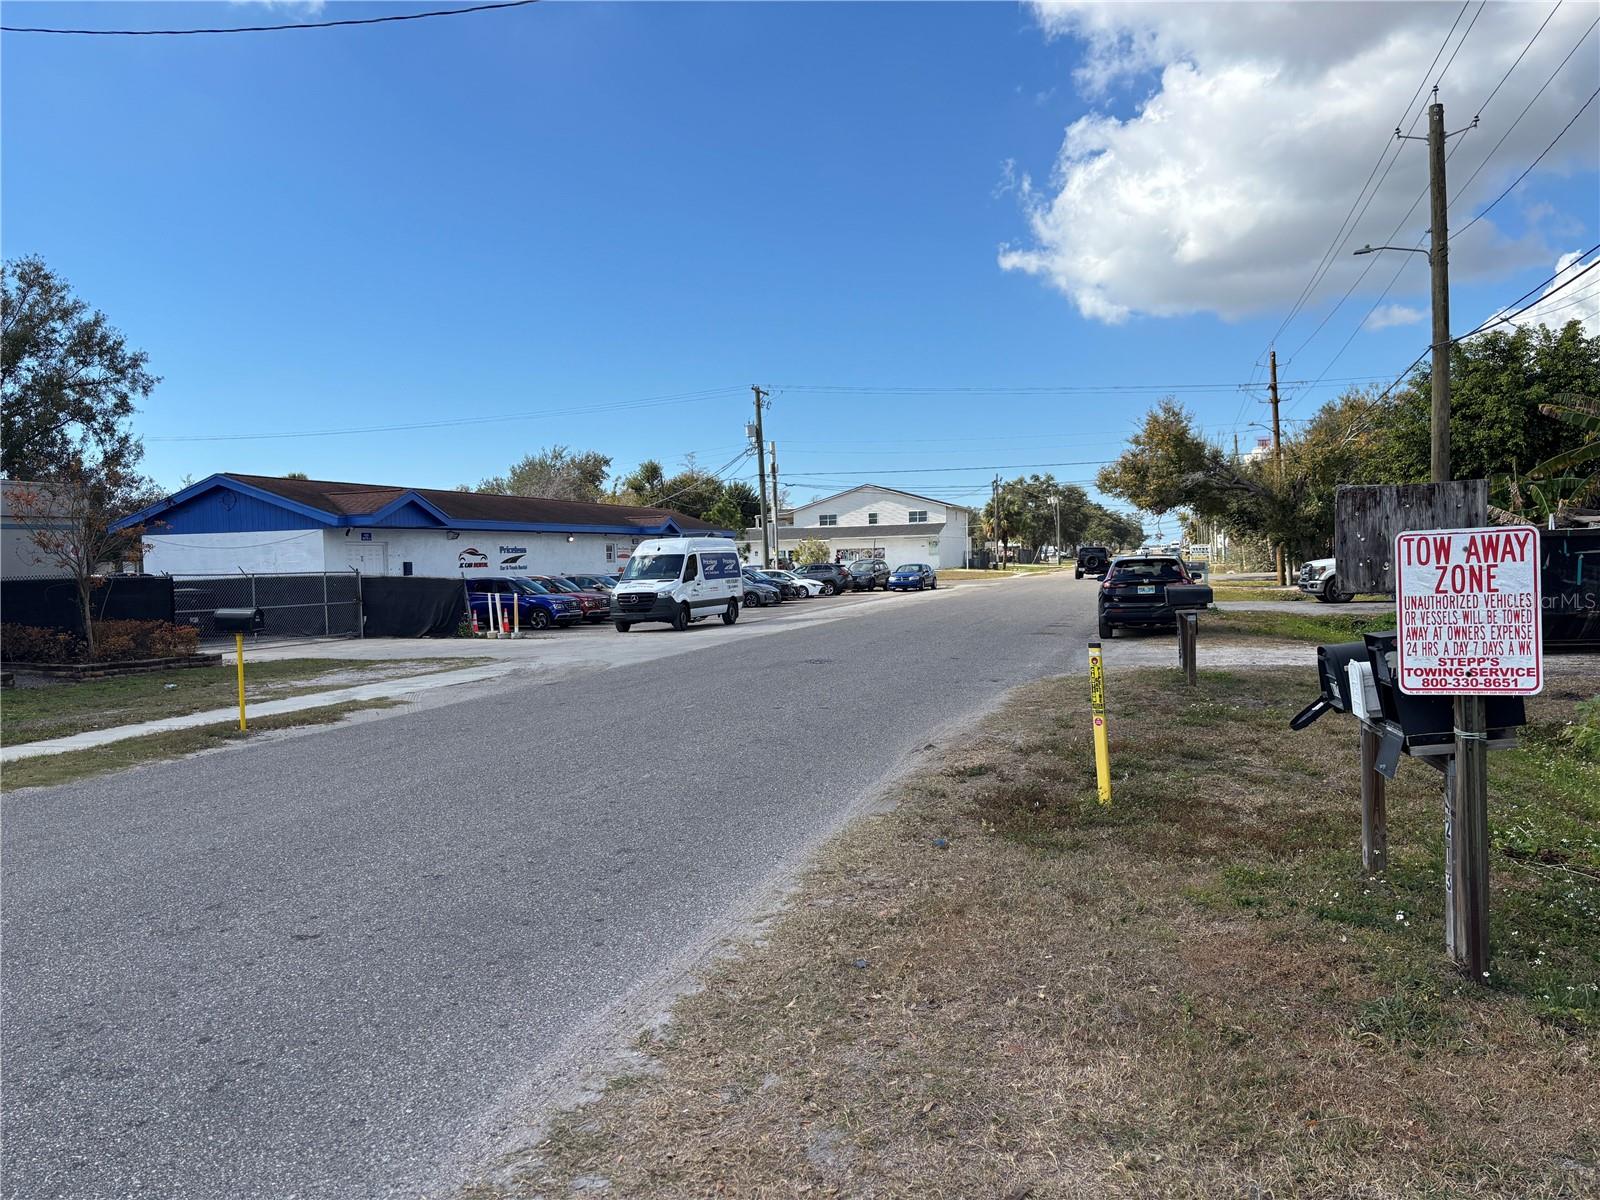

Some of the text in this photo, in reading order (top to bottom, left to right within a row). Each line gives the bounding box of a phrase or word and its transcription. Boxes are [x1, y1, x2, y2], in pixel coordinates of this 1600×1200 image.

[1403, 533, 1530, 566] TOW AWAY
[1435, 564, 1499, 594] ZONE
[1404, 593, 1532, 610] UNAUTHORIZED VEHICLES
[1405, 609, 1532, 626] OR VESSELS WILL BE TOWED
[1405, 625, 1533, 641] AWAY AT OWNERS EXPENSE
[1407, 641, 1532, 656] 24 HRS A DAY 7 DAYS A WK
[1438, 657, 1500, 667] STEPP'S
[1405, 667, 1536, 677] TOWING SERVICE
[1421, 678, 1519, 688] 800-330-8651
